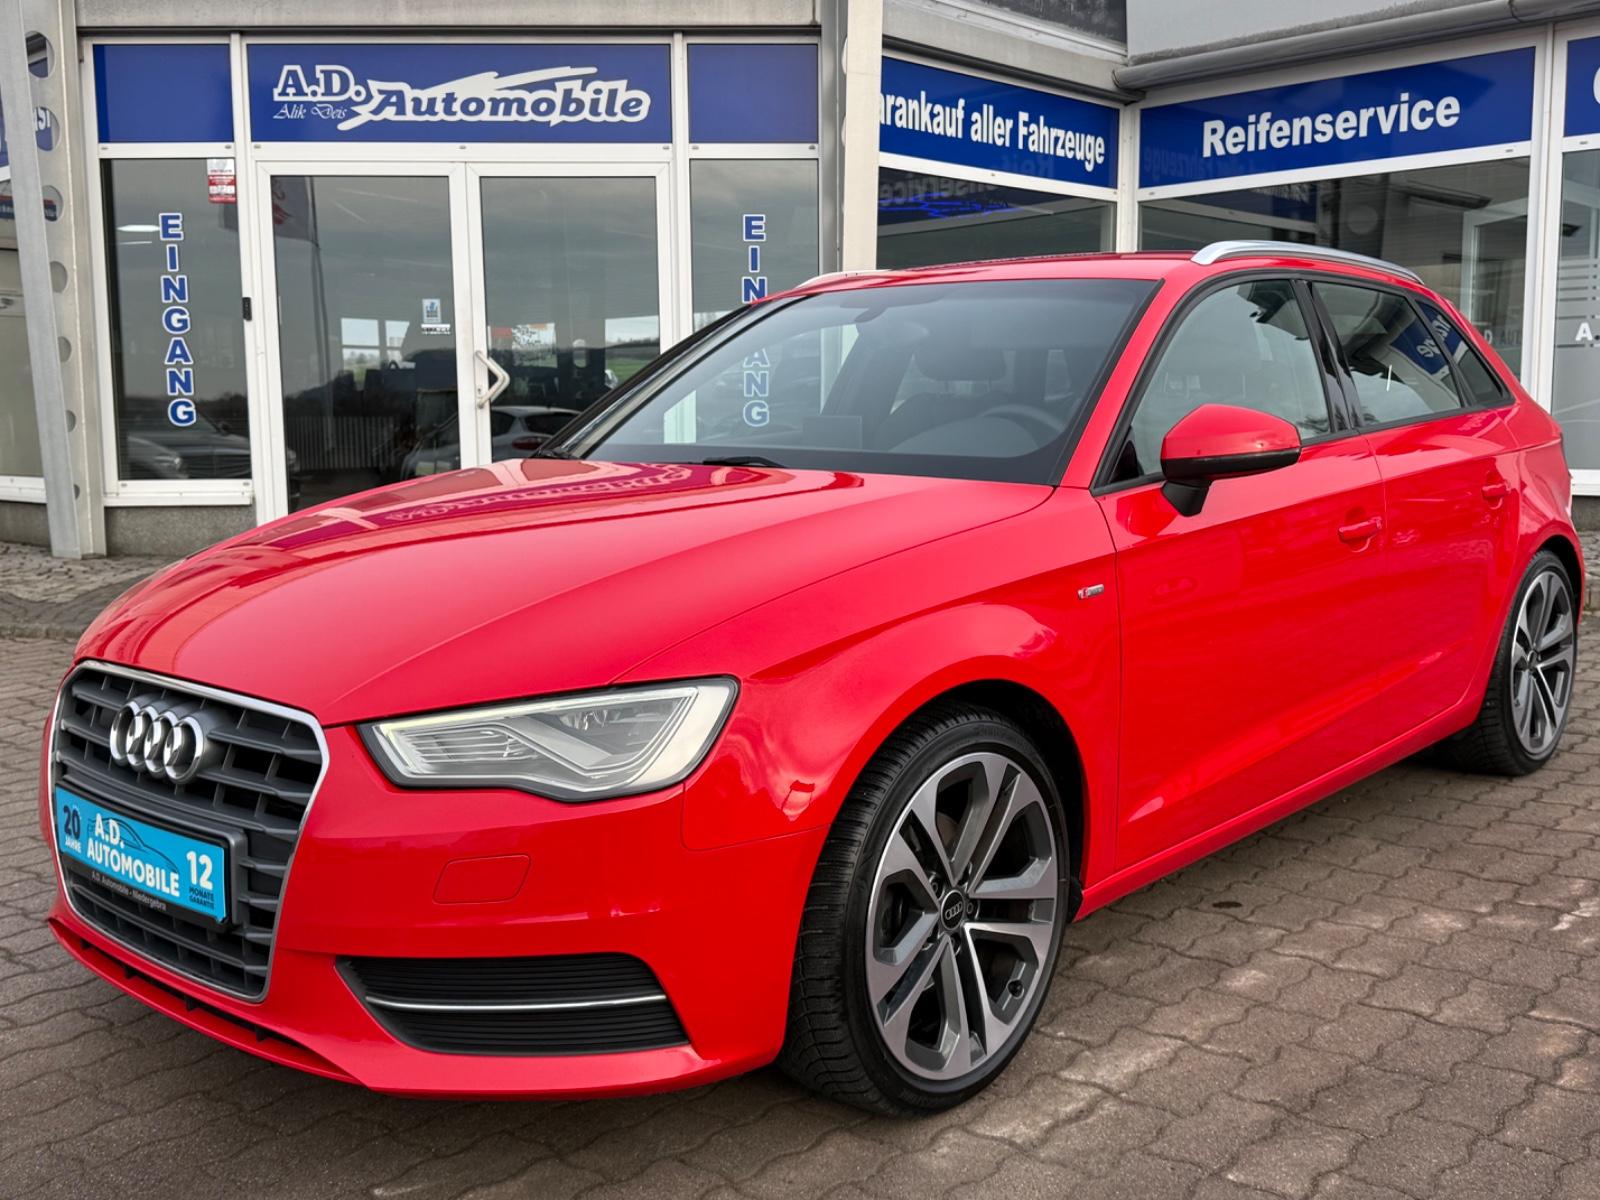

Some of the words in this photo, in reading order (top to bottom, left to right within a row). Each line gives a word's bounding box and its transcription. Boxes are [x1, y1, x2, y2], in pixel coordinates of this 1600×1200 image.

[273, 65, 366, 101] A.D.
[366, 80, 650, 123] Automobile
[273, 103, 307, 119] Alik
[970, 103, 1013, 147] aller
[1018, 111, 1105, 172] Fahrzeuge
[1202, 92, 1460, 158] Reifenservice
[159, 213, 196, 427] EINGANG
[742, 214, 770, 427] EINANG
[63, 804, 81, 840] 20
[94, 812, 125, 849] A.D.
[87, 837, 180, 897] AUTOMOBILE
[186, 851, 213, 891] 12
